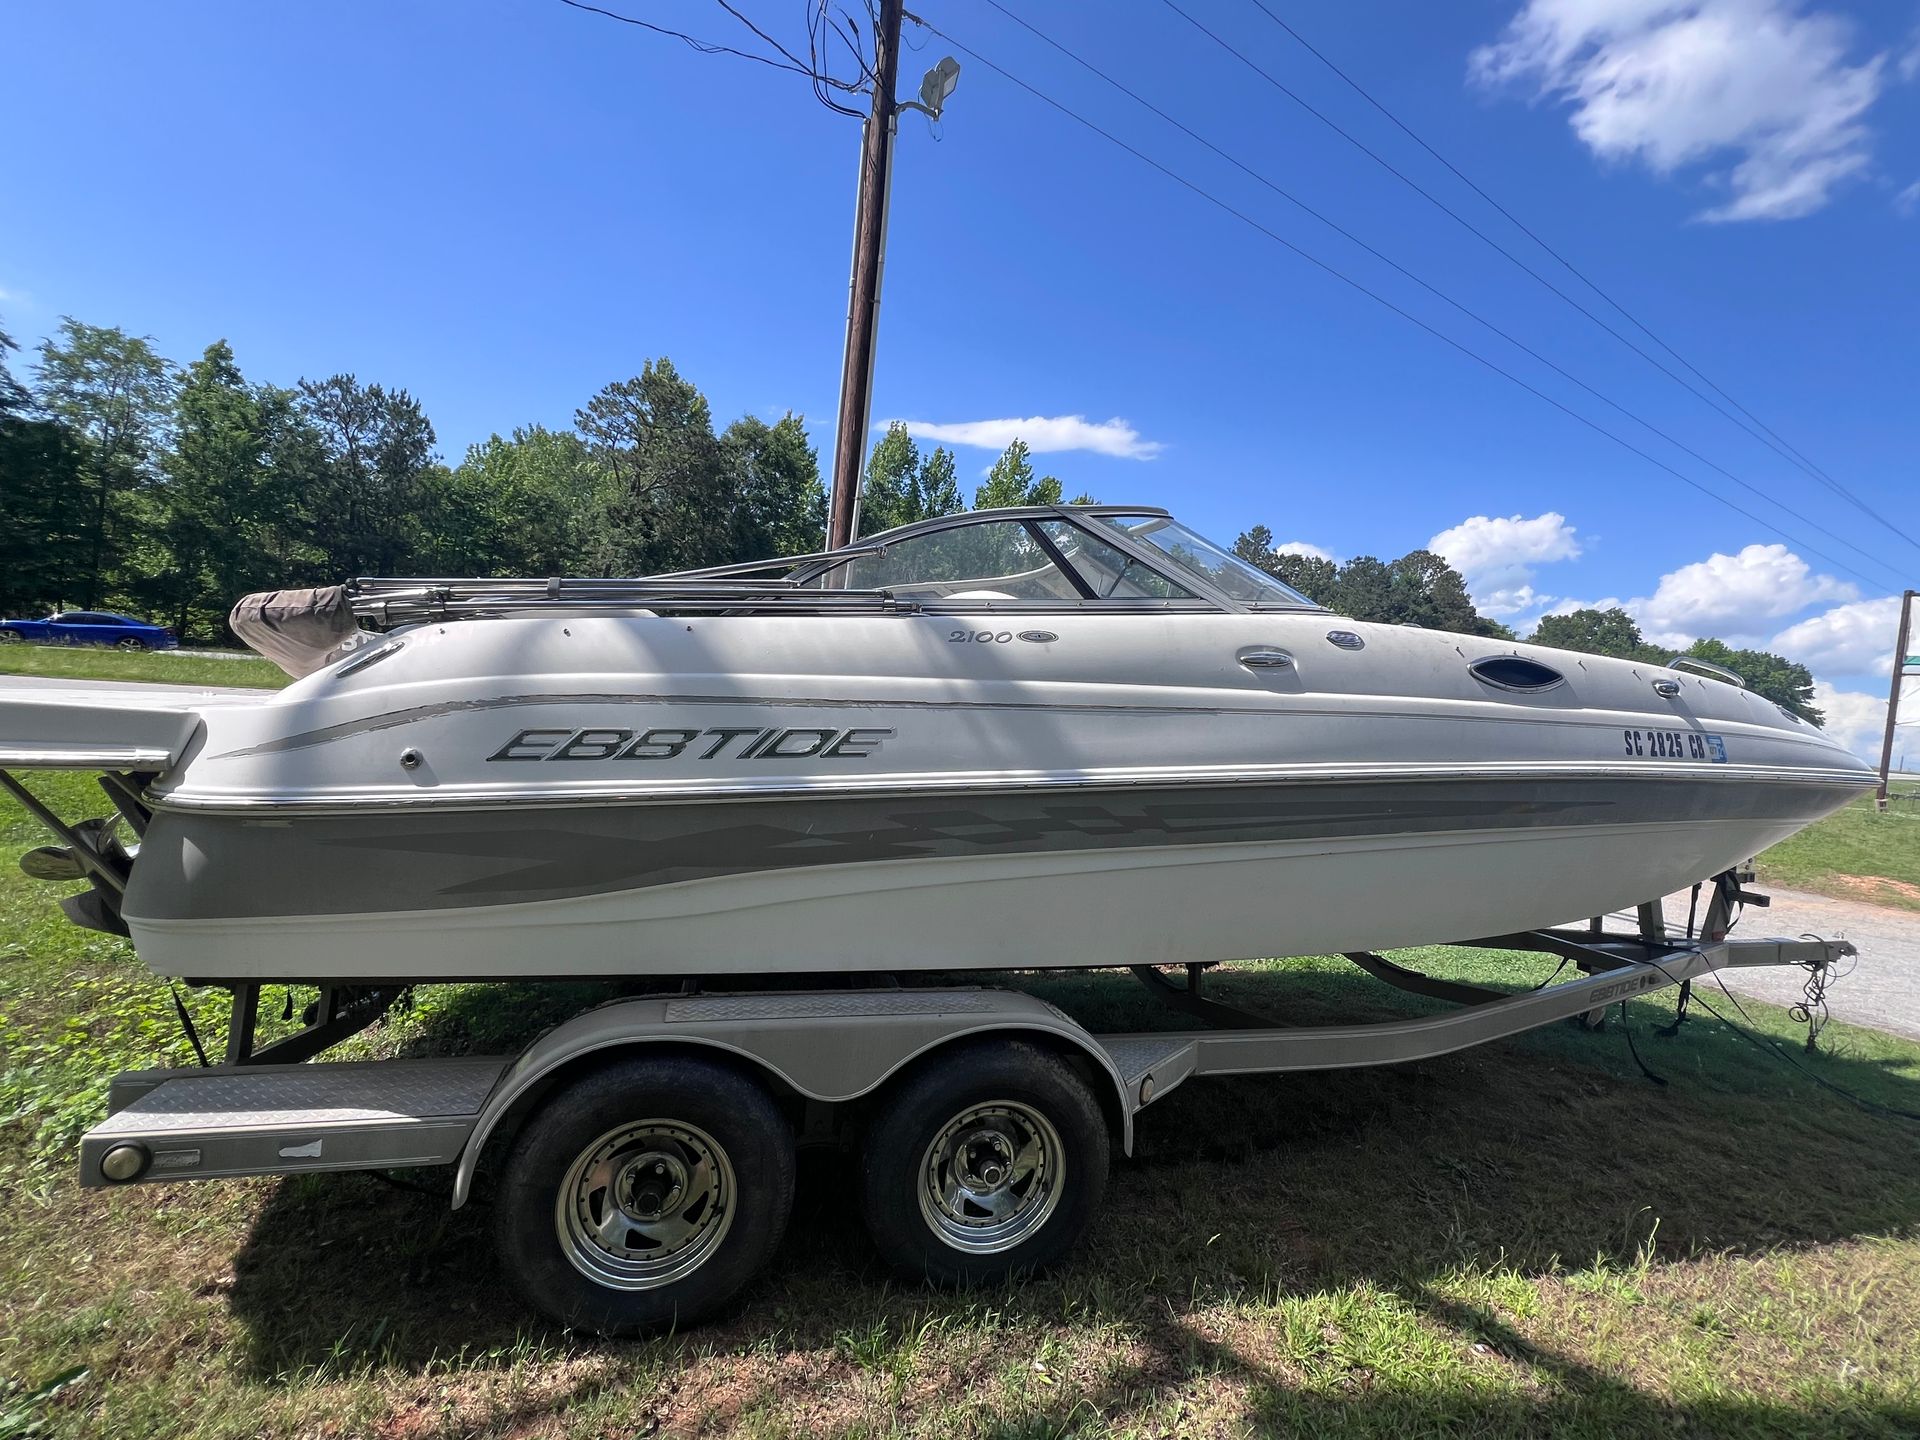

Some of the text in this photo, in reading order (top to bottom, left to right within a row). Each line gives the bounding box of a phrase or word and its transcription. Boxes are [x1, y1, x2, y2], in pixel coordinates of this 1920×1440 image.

[948, 630, 1013, 644] 2100
[486, 726, 896, 762] EBBTIDE
[1624, 730, 1643, 756] SC
[1647, 731, 1684, 758] 2825
[1589, 976, 1639, 1003] EBBTIDE
